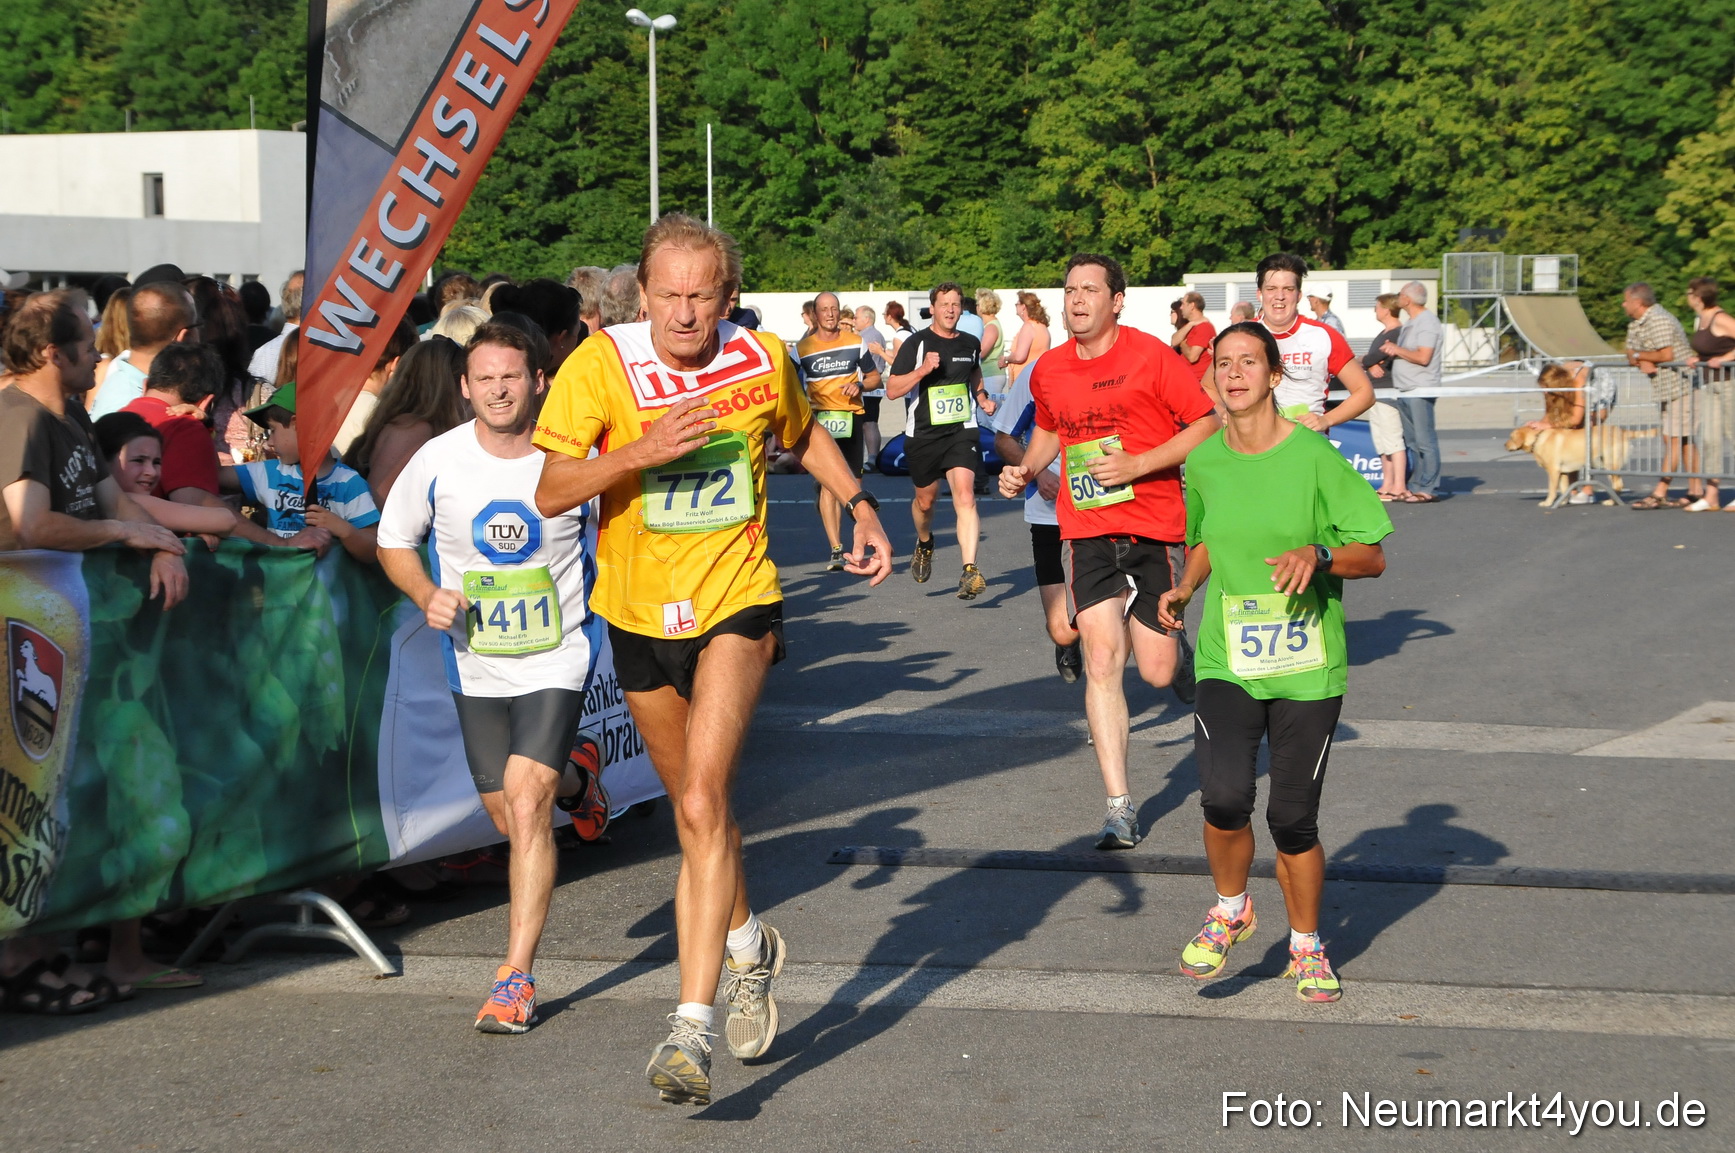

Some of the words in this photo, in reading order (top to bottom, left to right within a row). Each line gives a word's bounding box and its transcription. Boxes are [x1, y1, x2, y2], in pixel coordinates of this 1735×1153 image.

[818, 360, 851, 370] Fischer
[1091, 379, 1115, 390] swn
[710, 383, 778, 418] BÖGL
[936, 397, 964, 415] 978
[657, 469, 735, 511] 772
[676, 519, 706, 527] Bauservice
[707, 515, 724, 524] GmbH
[488, 524, 524, 539] TÜV
[498, 541, 516, 550] SÜD
[469, 596, 550, 632] 1411
[1238, 608, 1271, 616] firmenlauf
[513, 639, 533, 647] SERVICE
[1240, 620, 1308, 658] 575
[1267, 663, 1295, 671] Landkreises
[1296, 658, 1319, 666] Neumarkt
